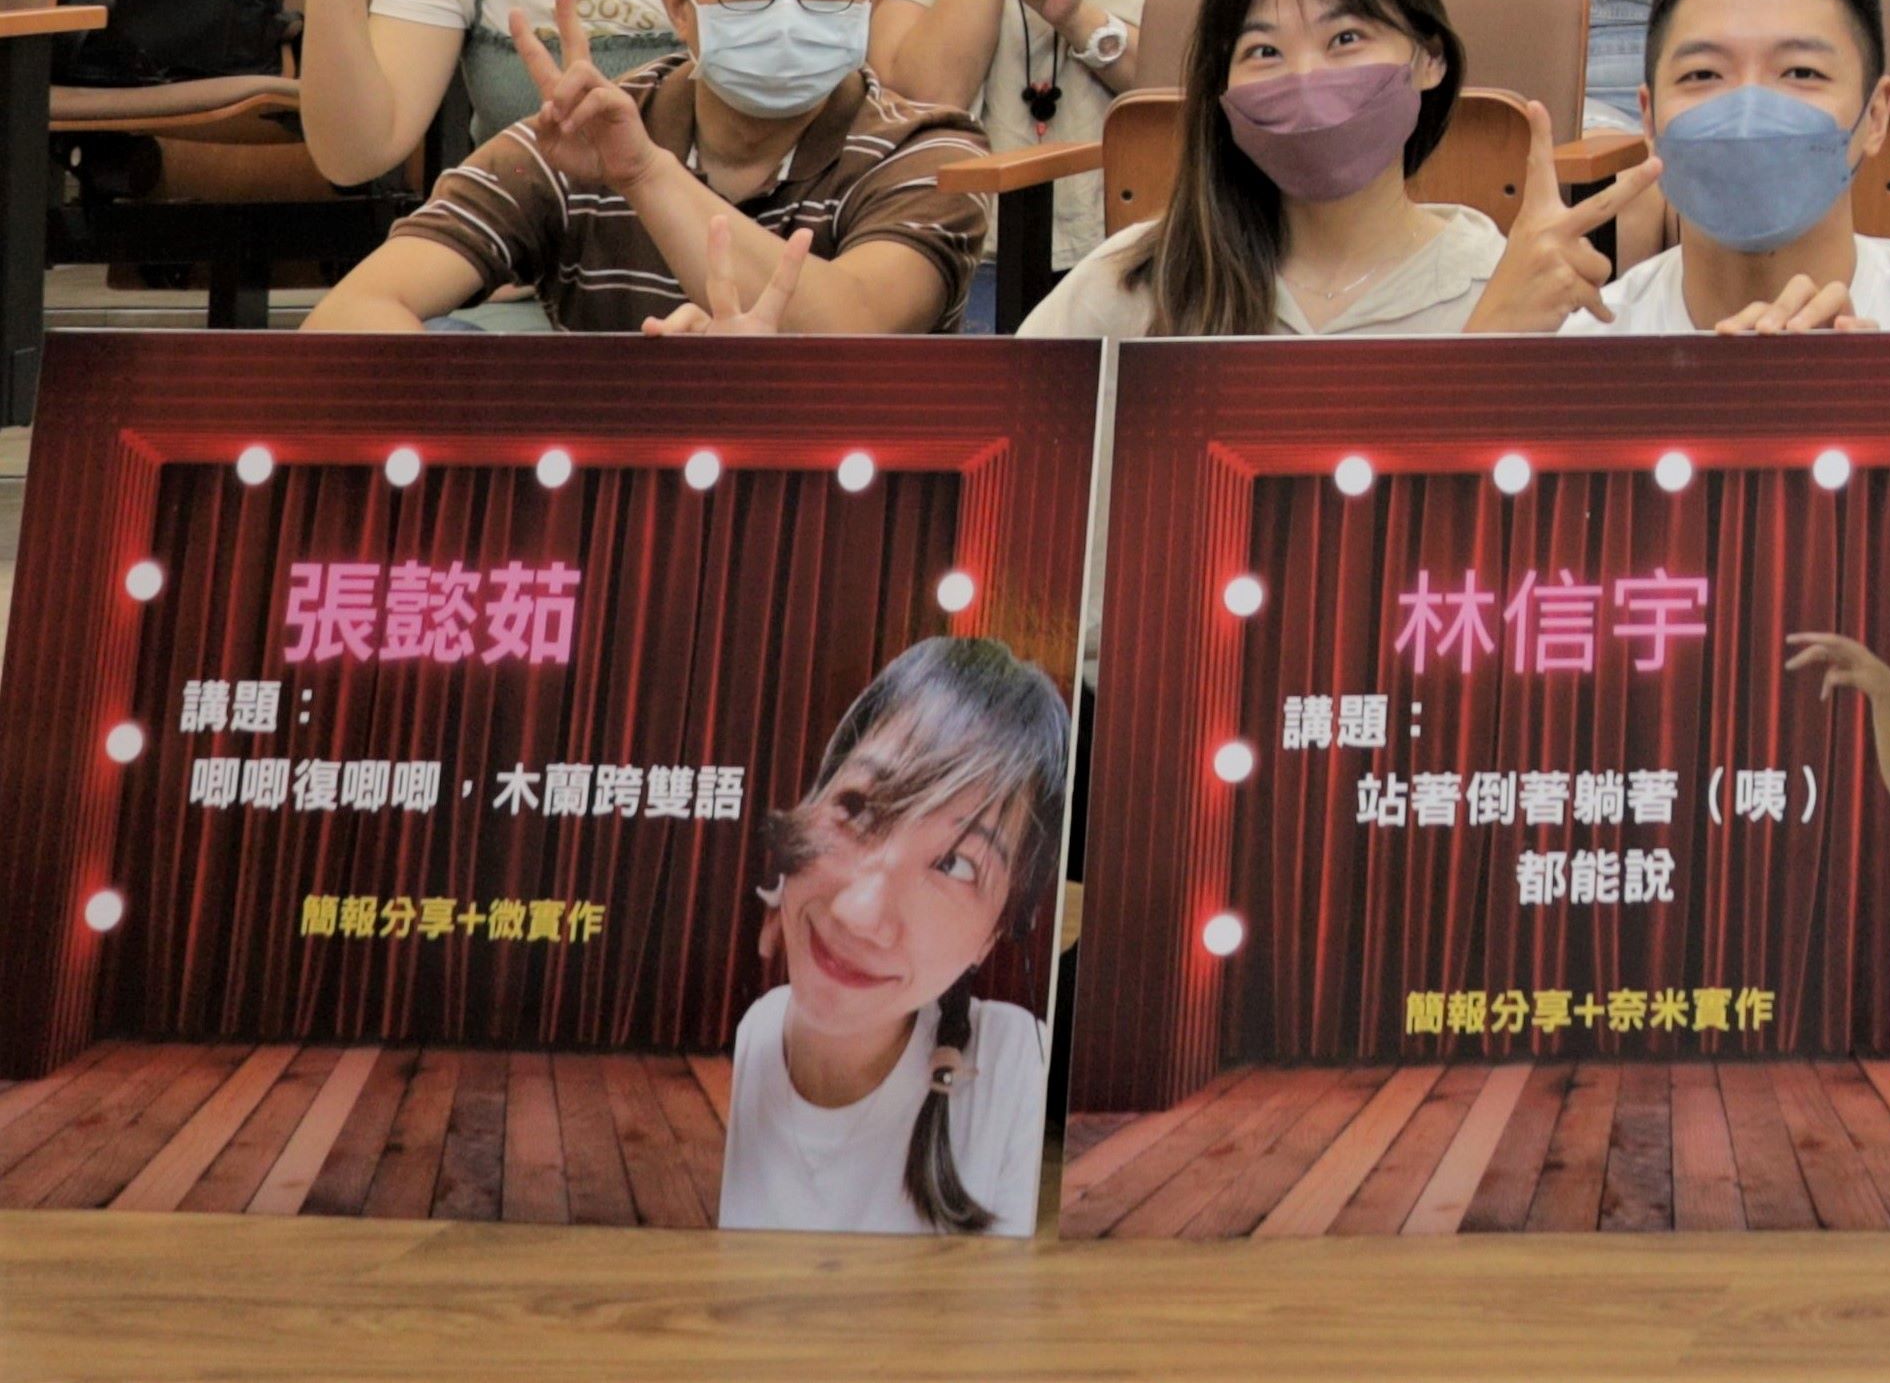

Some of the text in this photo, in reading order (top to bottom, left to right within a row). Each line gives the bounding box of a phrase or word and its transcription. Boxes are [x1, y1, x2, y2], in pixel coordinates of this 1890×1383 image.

[286, 561, 580, 663] 張懿茹
[1395, 568, 1707, 673] 林信宇
[1517, 849, 1675, 904] 都能說
